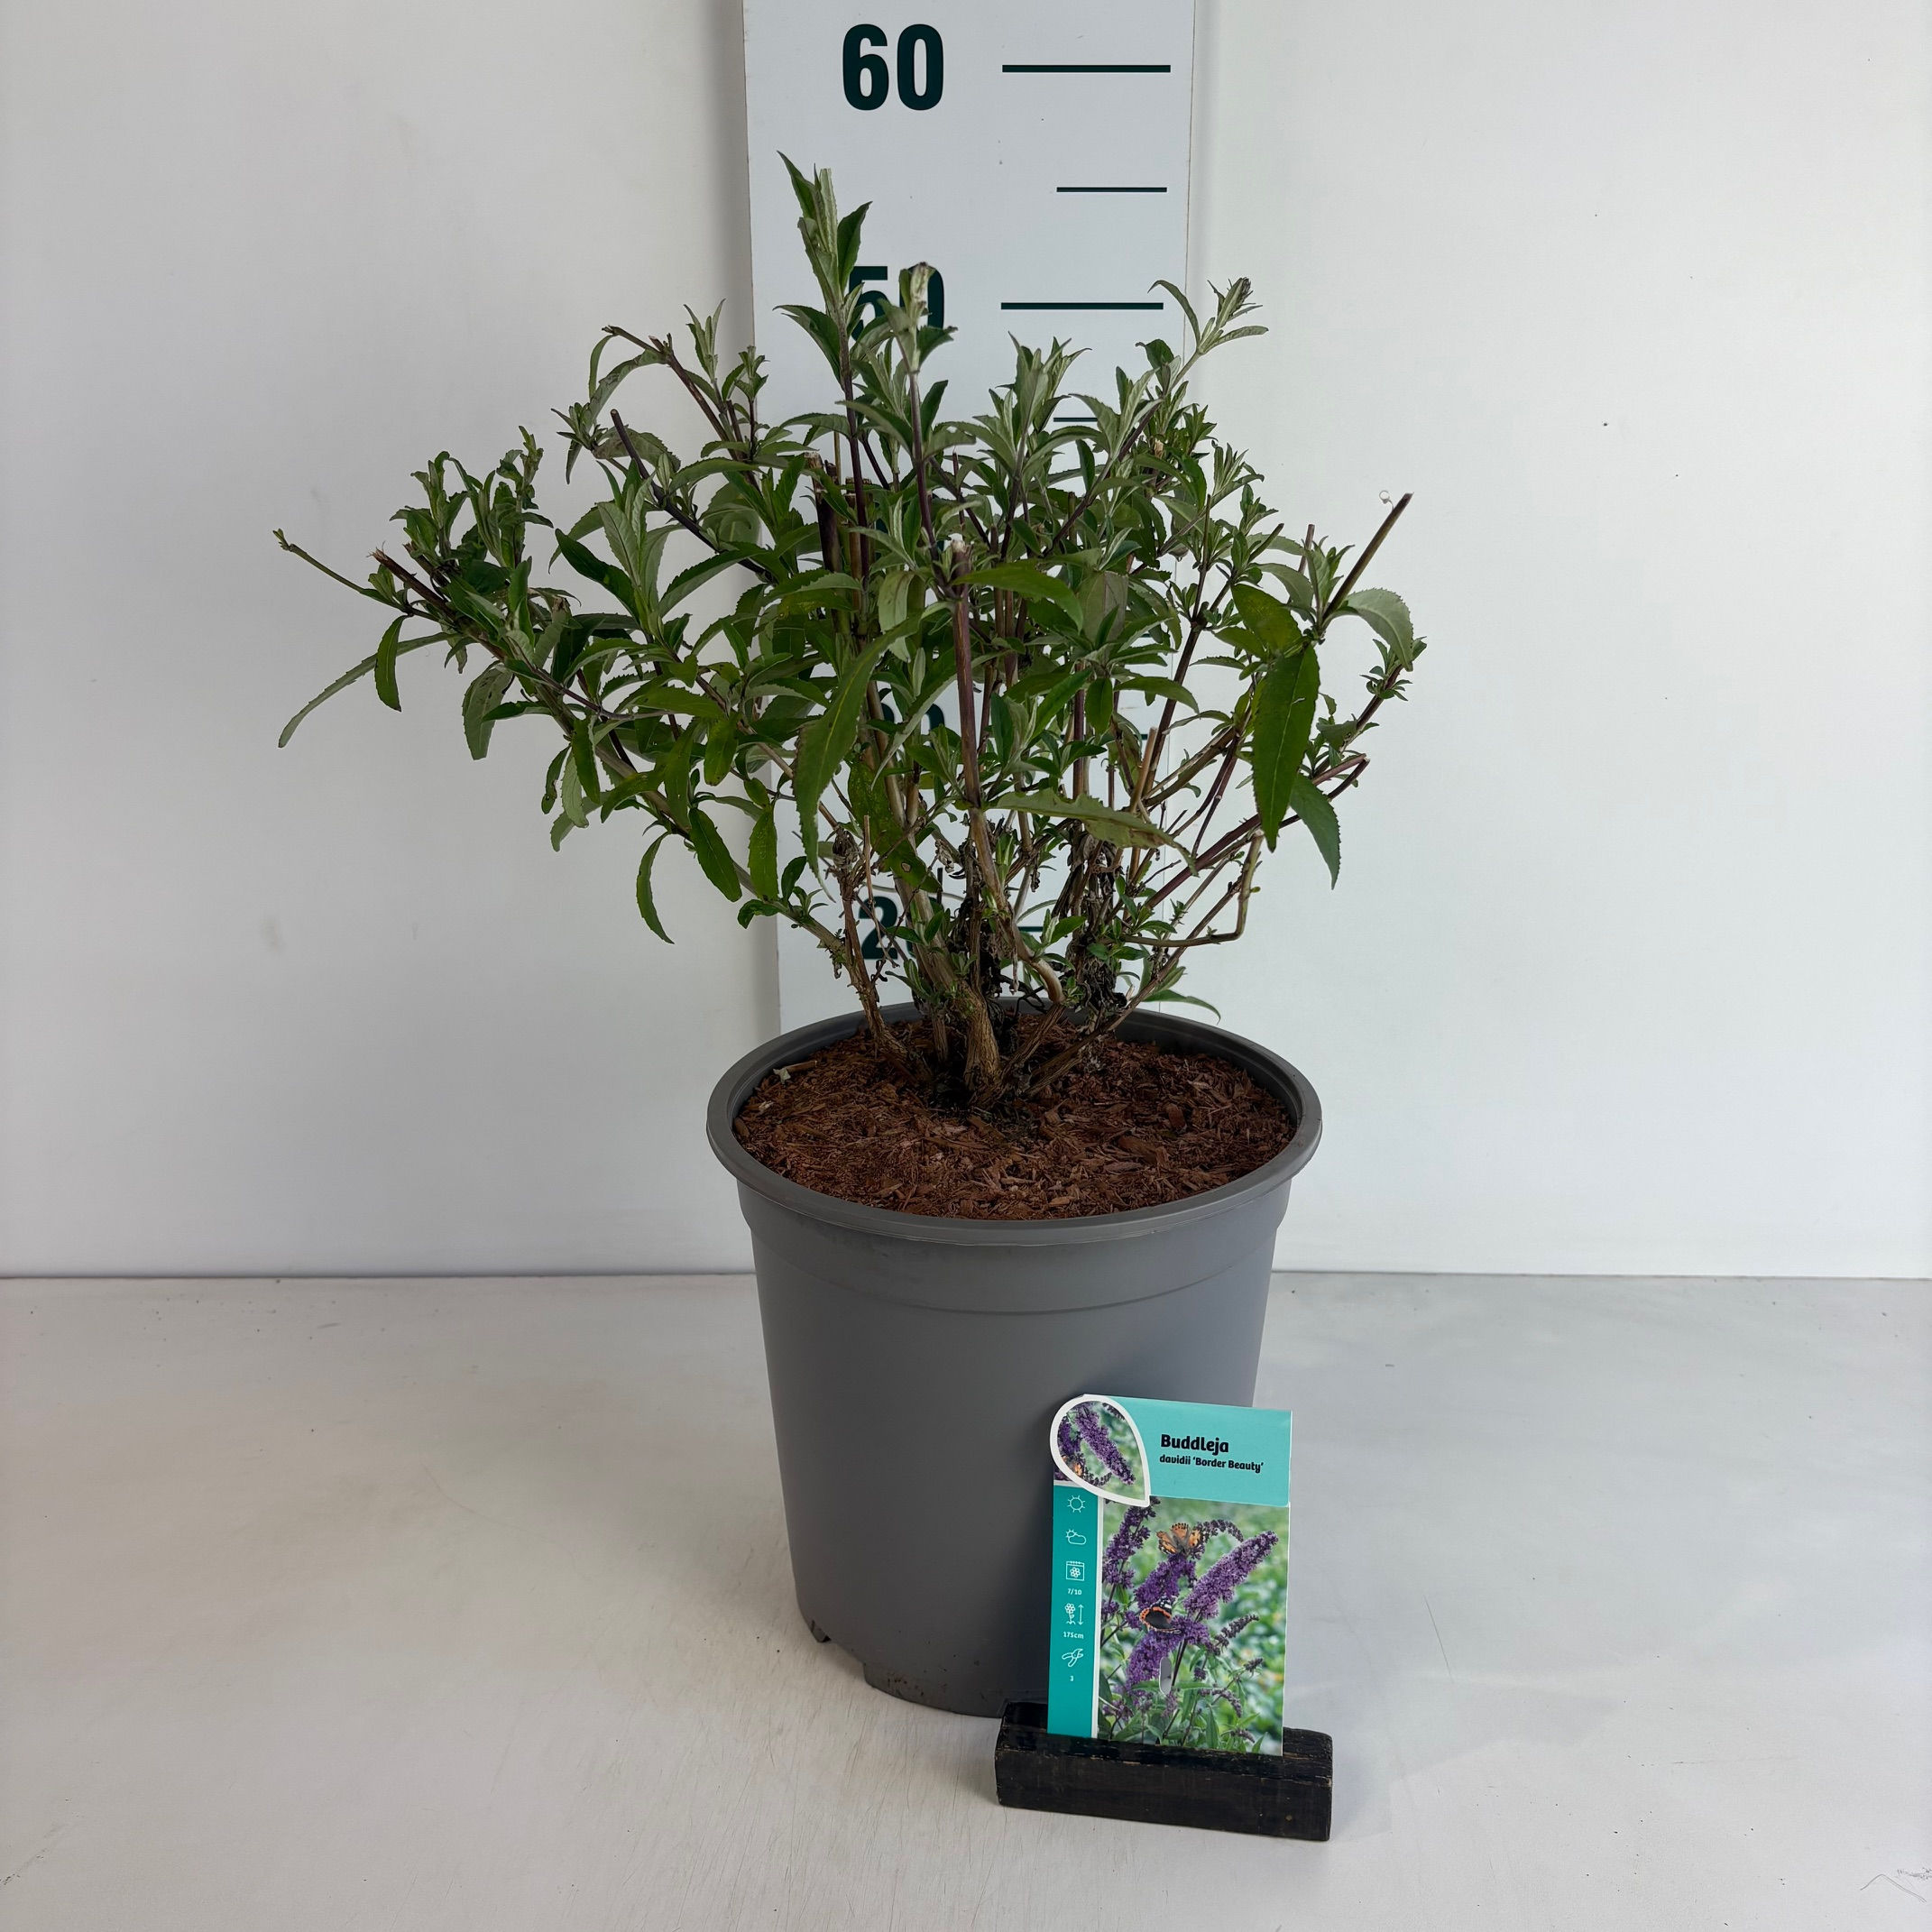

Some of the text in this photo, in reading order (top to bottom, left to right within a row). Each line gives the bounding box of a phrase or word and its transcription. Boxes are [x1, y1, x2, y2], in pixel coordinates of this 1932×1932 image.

[842, 23, 944, 111] 60
[858, 896, 942, 960] 2
[1160, 1433, 1229, 1456] Buddleja
[1159, 1454, 1191, 1465] davidii
[1067, 1587, 1082, 1596] 7/10
[1063, 1631, 1084, 1639] 175cm
